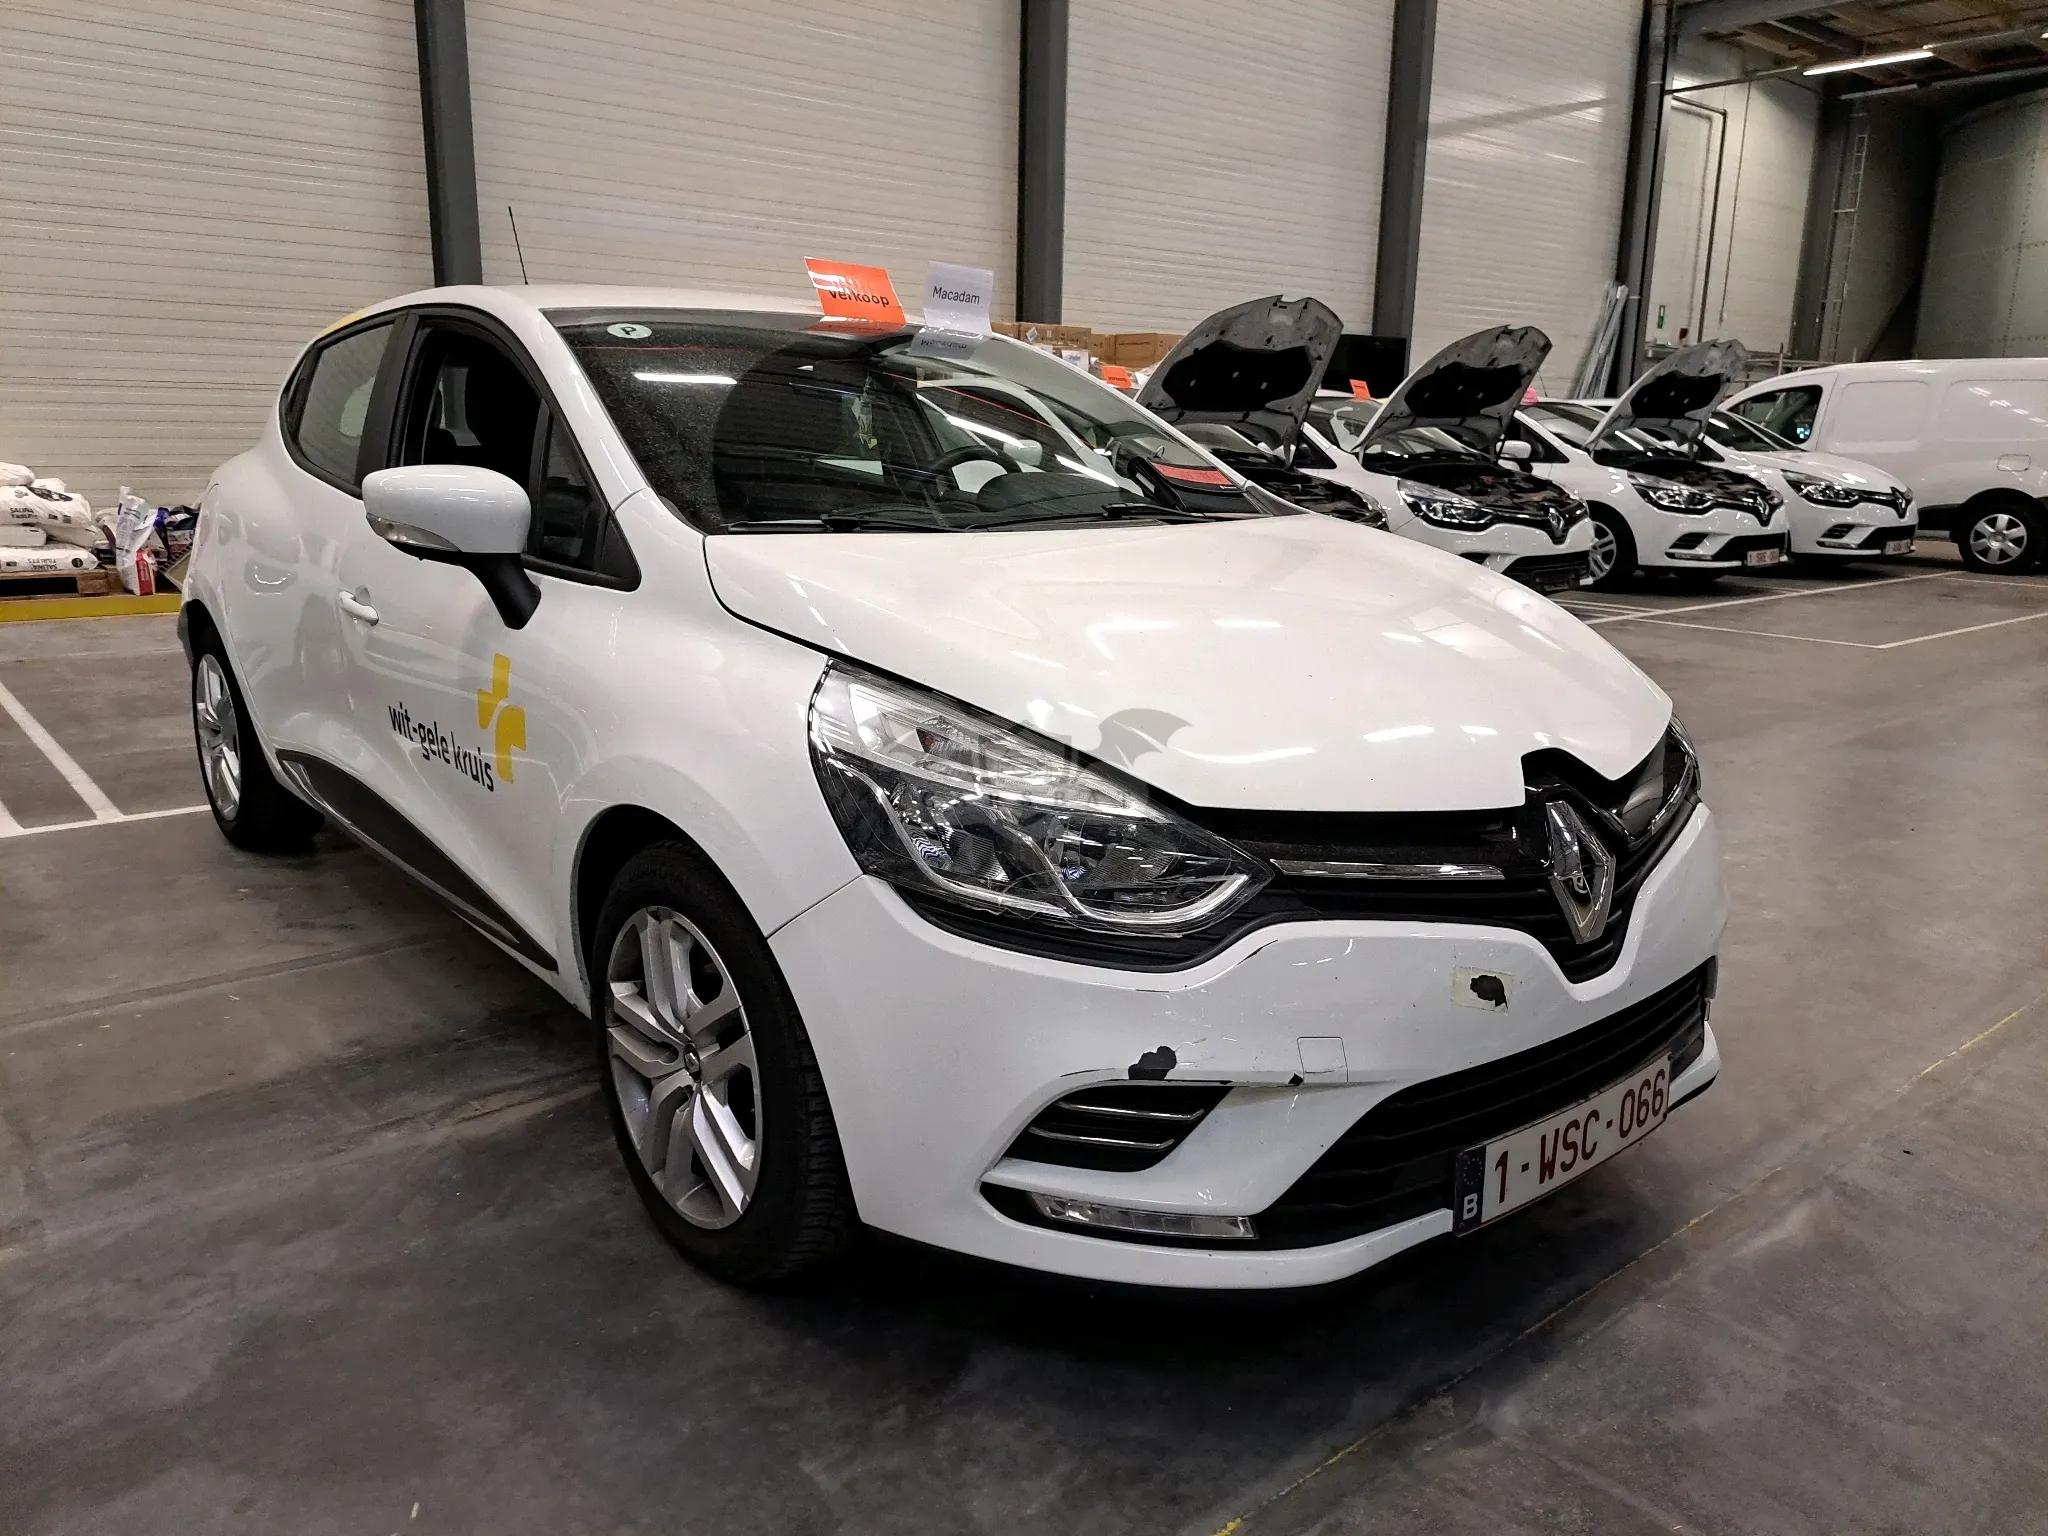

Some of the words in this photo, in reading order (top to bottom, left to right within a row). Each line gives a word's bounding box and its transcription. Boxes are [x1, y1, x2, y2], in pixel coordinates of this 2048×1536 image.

[932, 286, 981, 304] Macadam
[620, 326, 637, 335] P
[388, 702, 451, 765] wit-gele
[451, 731, 495, 792] kruis
[1495, 1068, 1666, 1204] 1-WSC-066
[1463, 1192, 1478, 1220] B
